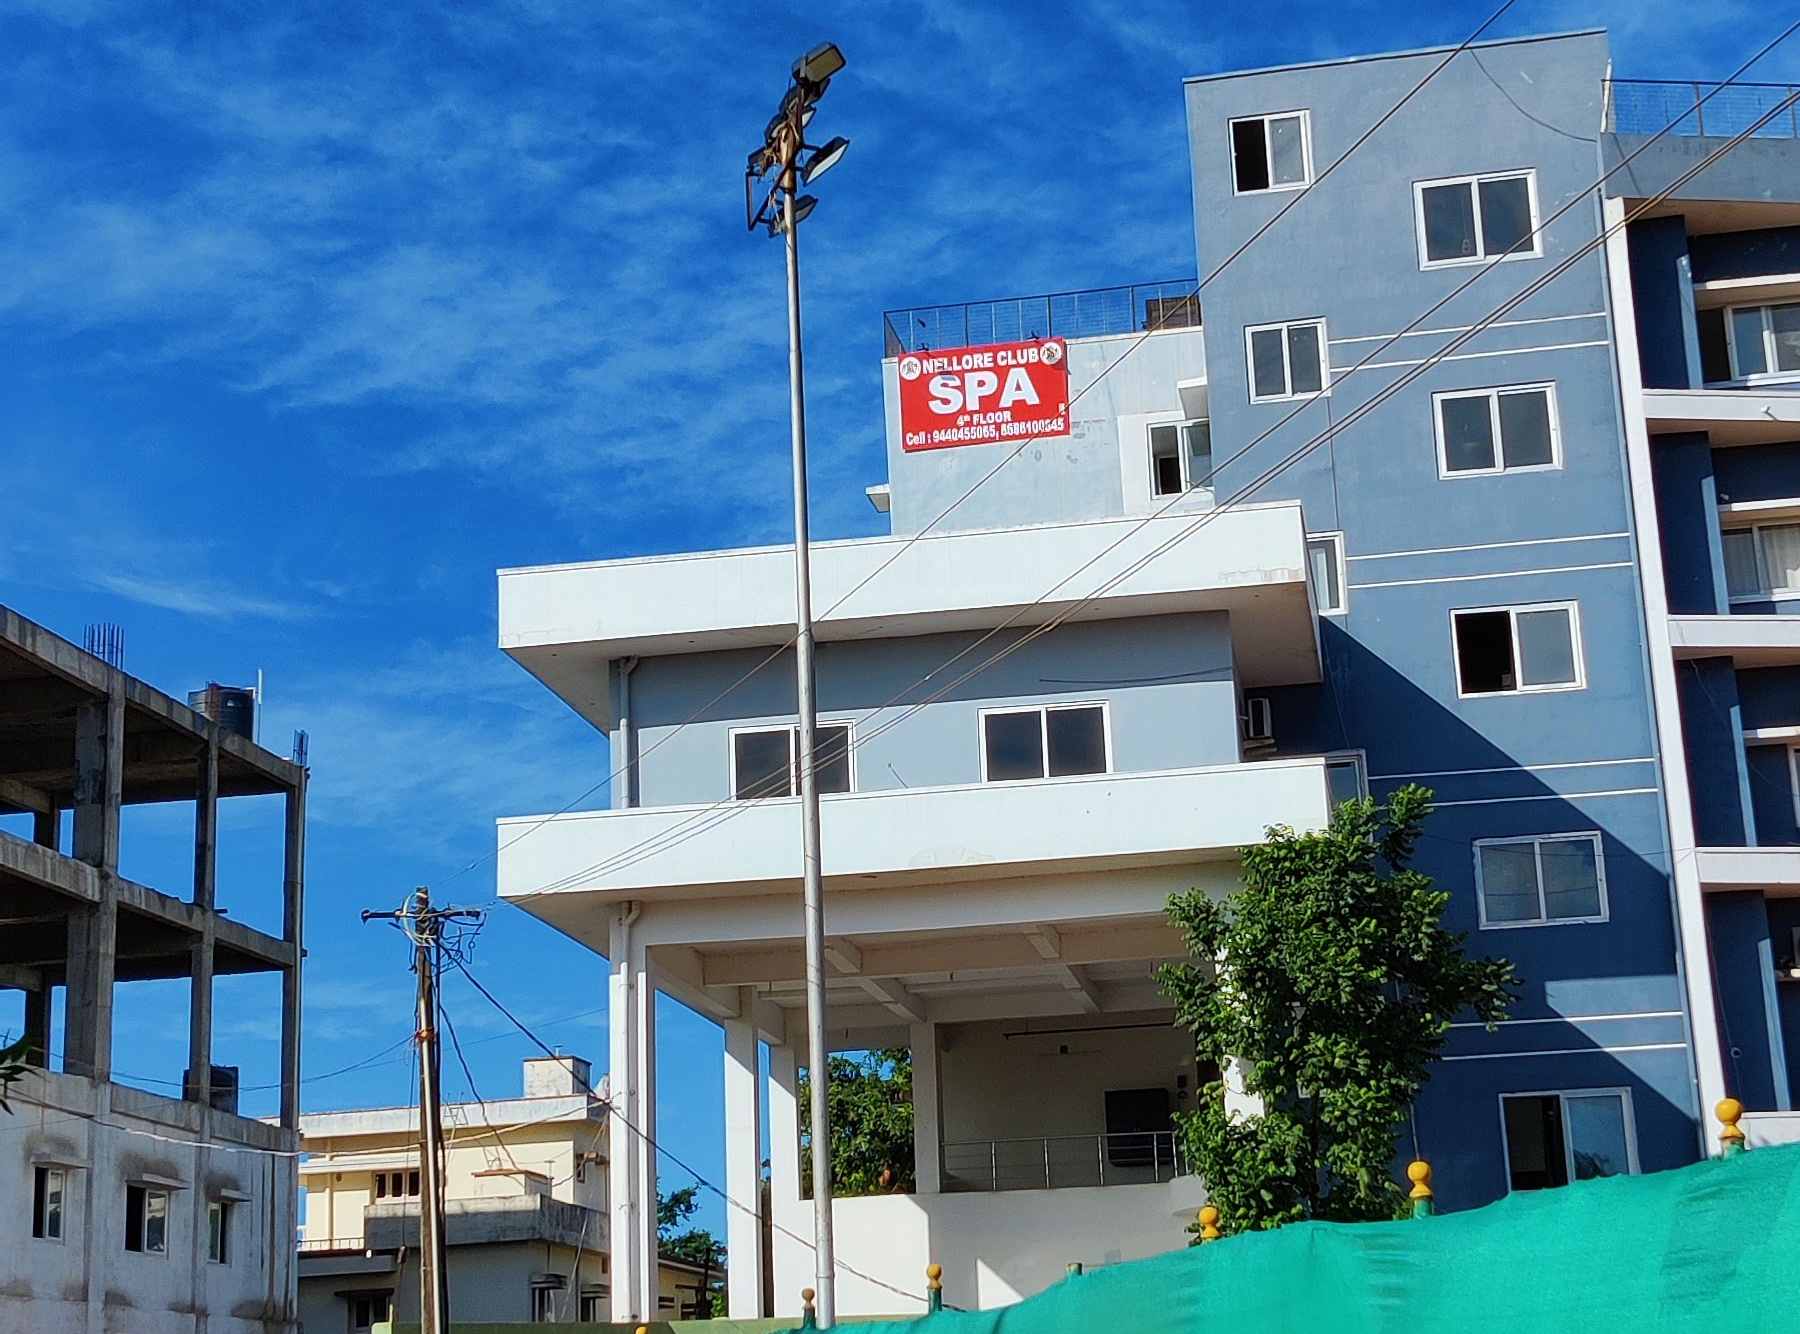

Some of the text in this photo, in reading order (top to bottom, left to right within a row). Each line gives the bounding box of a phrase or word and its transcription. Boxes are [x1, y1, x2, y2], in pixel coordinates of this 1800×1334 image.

[923, 349, 1039, 374] NELLORE CLUB
[928, 367, 1040, 414] SPA
[973, 411, 1012, 424] FLOOR
[906, 432, 925, 445] Cell
